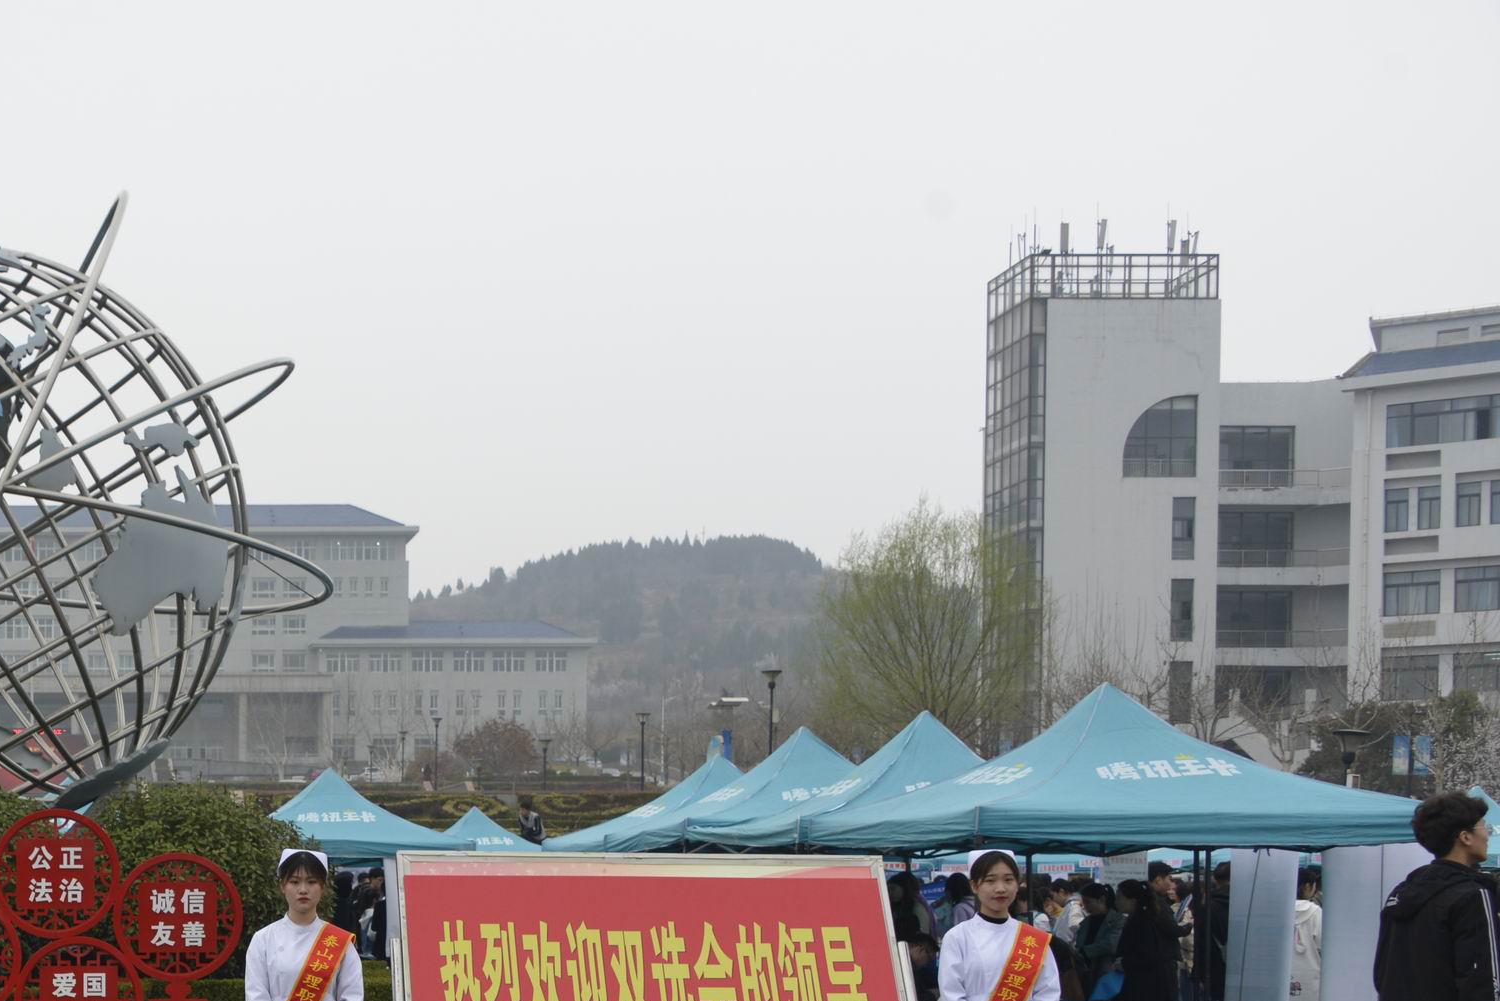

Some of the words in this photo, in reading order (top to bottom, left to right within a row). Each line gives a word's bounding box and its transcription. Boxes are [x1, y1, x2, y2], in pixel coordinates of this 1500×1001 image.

[1096, 757, 1242, 780] 腾讯王卡
[28, 846, 84, 870] 公正
[28, 878, 84, 903] 法治
[150, 889, 206, 913] 诚信
[150, 921, 206, 946] 友善
[52, 973, 106, 997] 爱国
